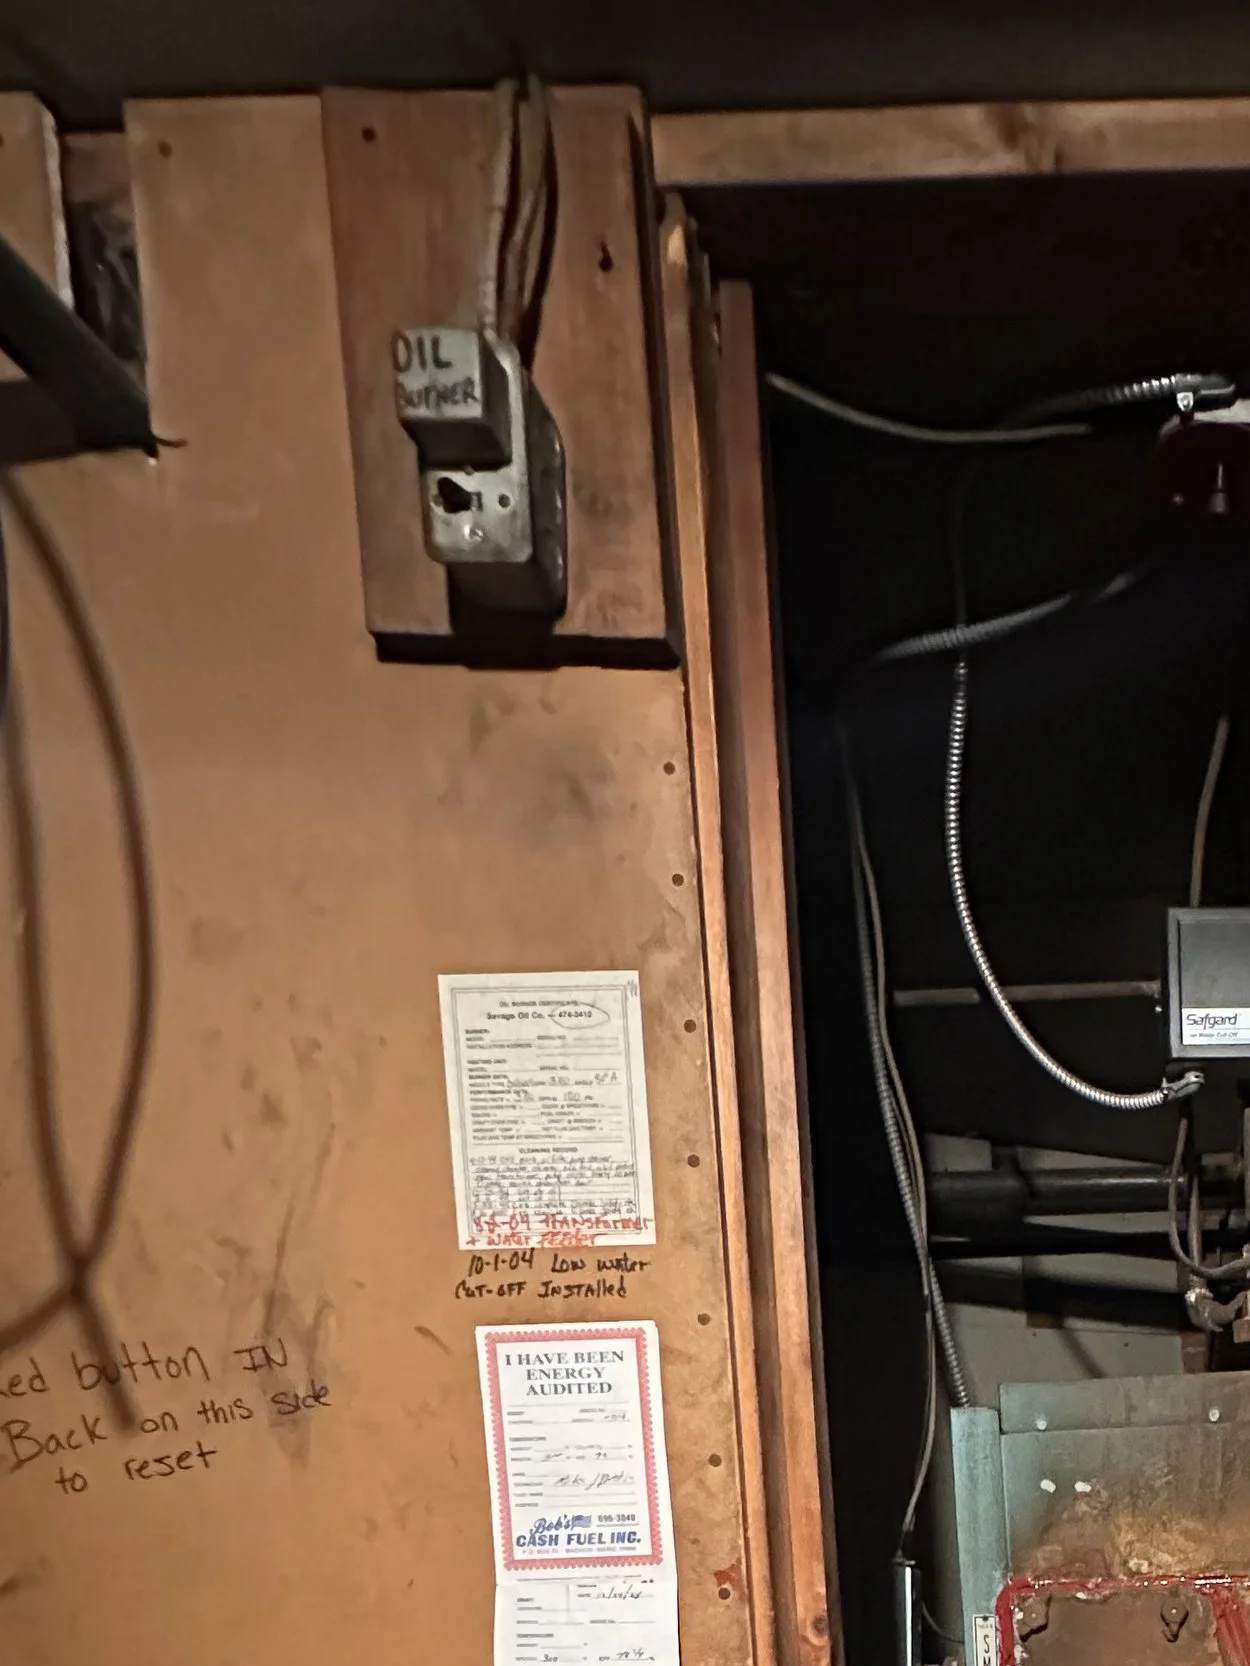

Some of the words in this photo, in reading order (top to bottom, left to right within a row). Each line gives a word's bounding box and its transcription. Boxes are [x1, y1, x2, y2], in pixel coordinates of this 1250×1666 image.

[390, 330, 453, 373] OIL
[518, 1011, 530, 1020] Oil
[1186, 1012, 1238, 1030] Safgard
[467, 1247, 535, 1277] 10-1-04
[0, 1356, 49, 1397] ed
[71, 1342, 210, 1391] button
[234, 1338, 288, 1373] IN
[504, 1354, 511, 1366] I
[517, 1352, 569, 1366] HAVE
[574, 1350, 624, 1364] BEEN
[526, 1367, 605, 1381] ENERGY
[526, 1382, 612, 1396] AUDITED
[0, 1414, 108, 1473] Back
[140, 1411, 179, 1434] on
[197, 1398, 253, 1425] this
[55, 1466, 88, 1495] to
[124, 1441, 217, 1481] reset
[529, 1513, 571, 1536] Bob's
[516, 1534, 559, 1548] CASH
[566, 1532, 607, 1546] FUEL
[610, 1531, 642, 1544] INC.
